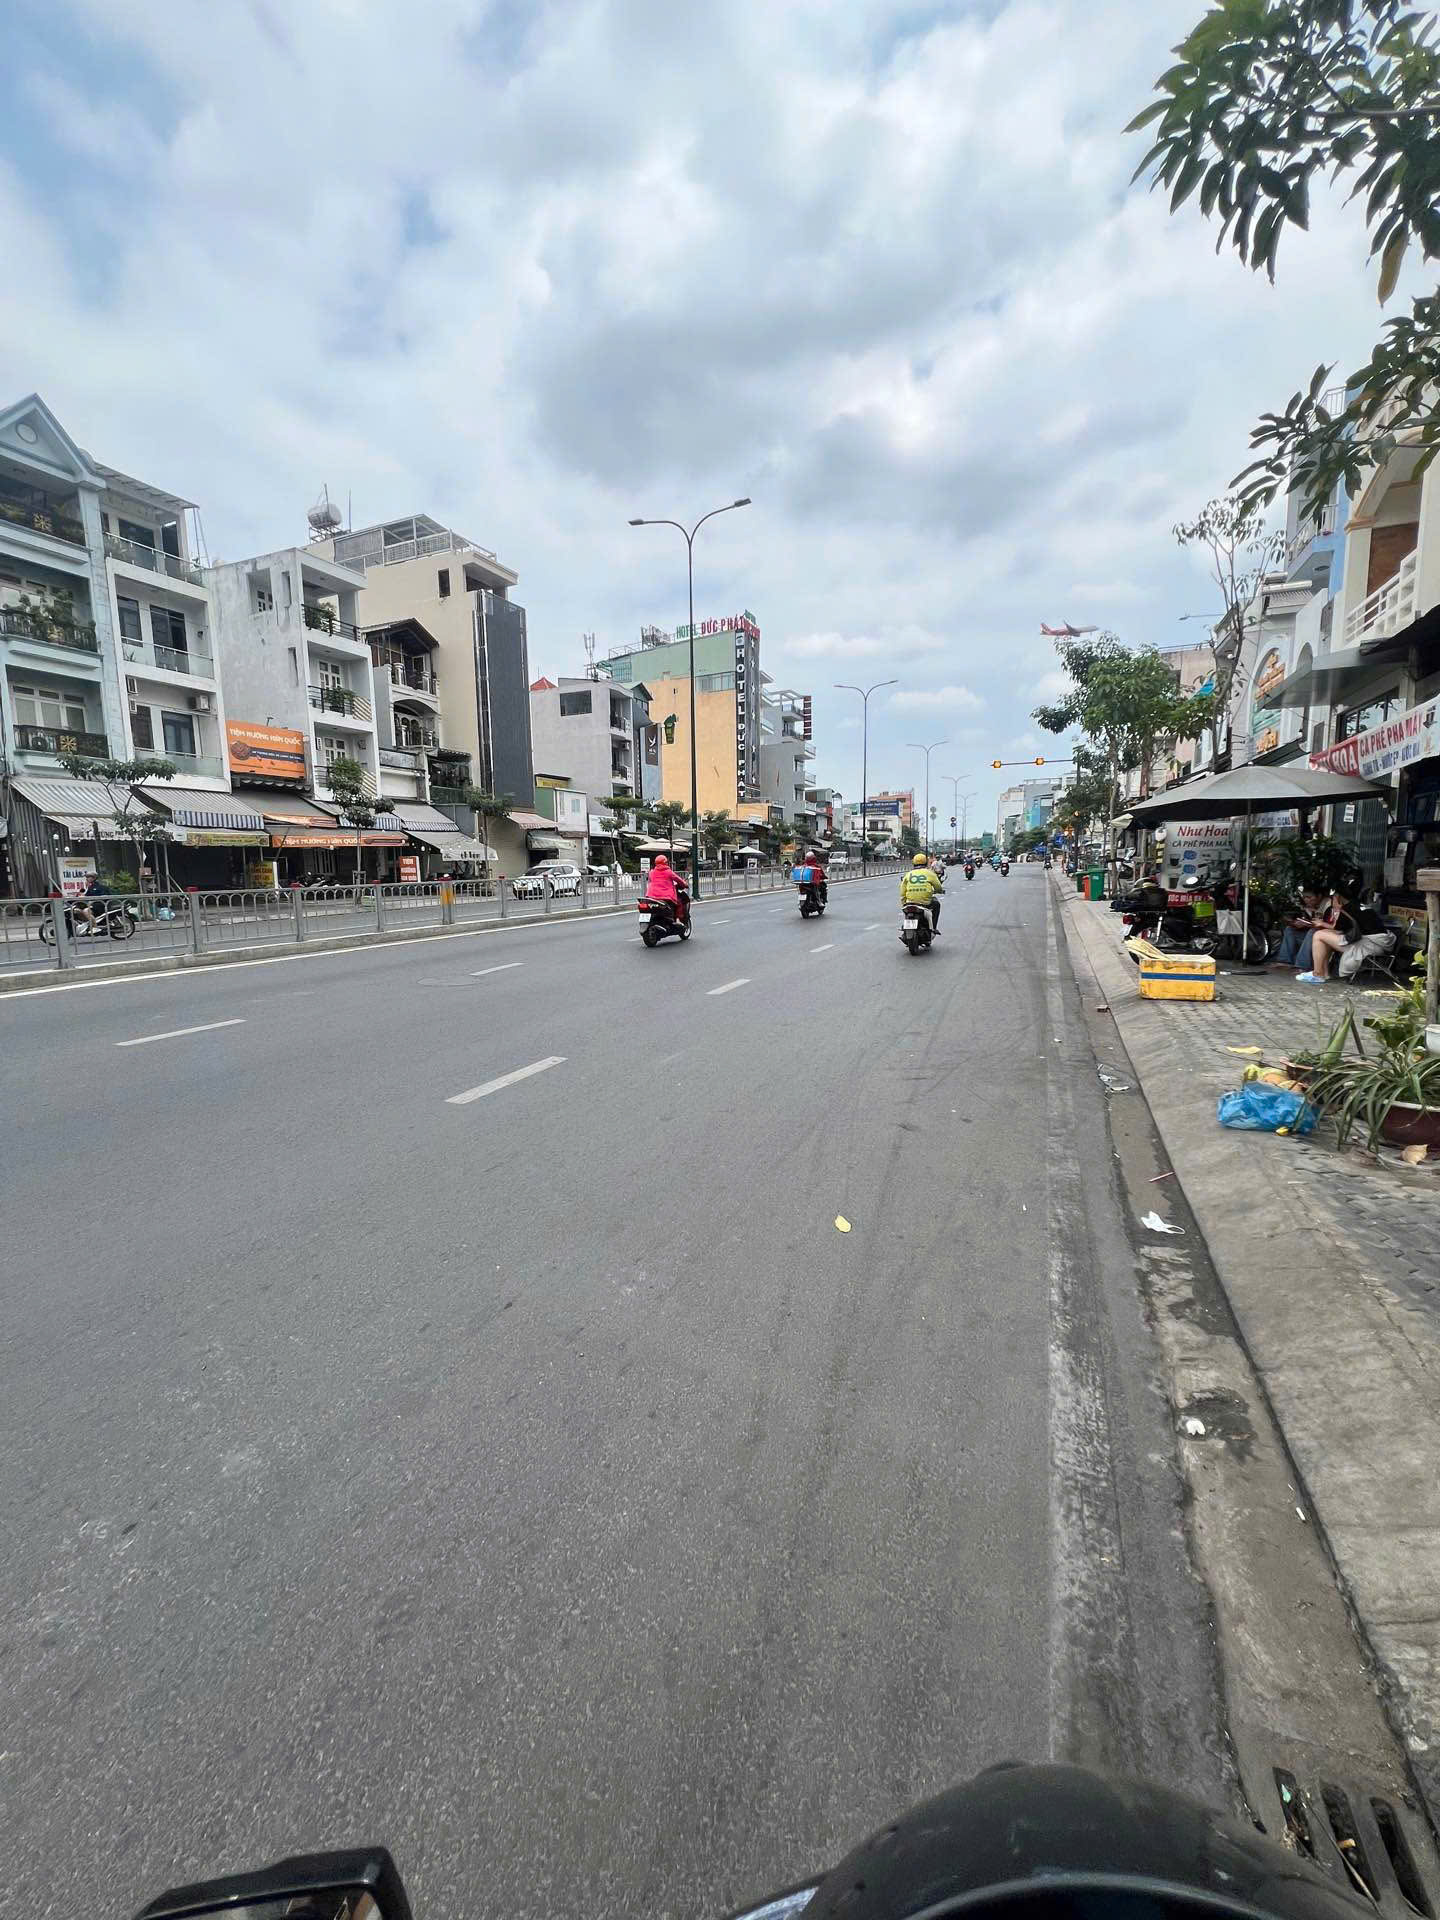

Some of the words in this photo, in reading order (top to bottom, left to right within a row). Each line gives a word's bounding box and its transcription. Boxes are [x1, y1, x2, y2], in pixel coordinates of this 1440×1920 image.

[676, 623, 698, 640] HOTL
[736, 648, 746, 715] HOTEL
[1177, 825, 1203, 837] Như
[1204, 824, 1229, 837] Hoa
[909, 872, 927, 884] be
